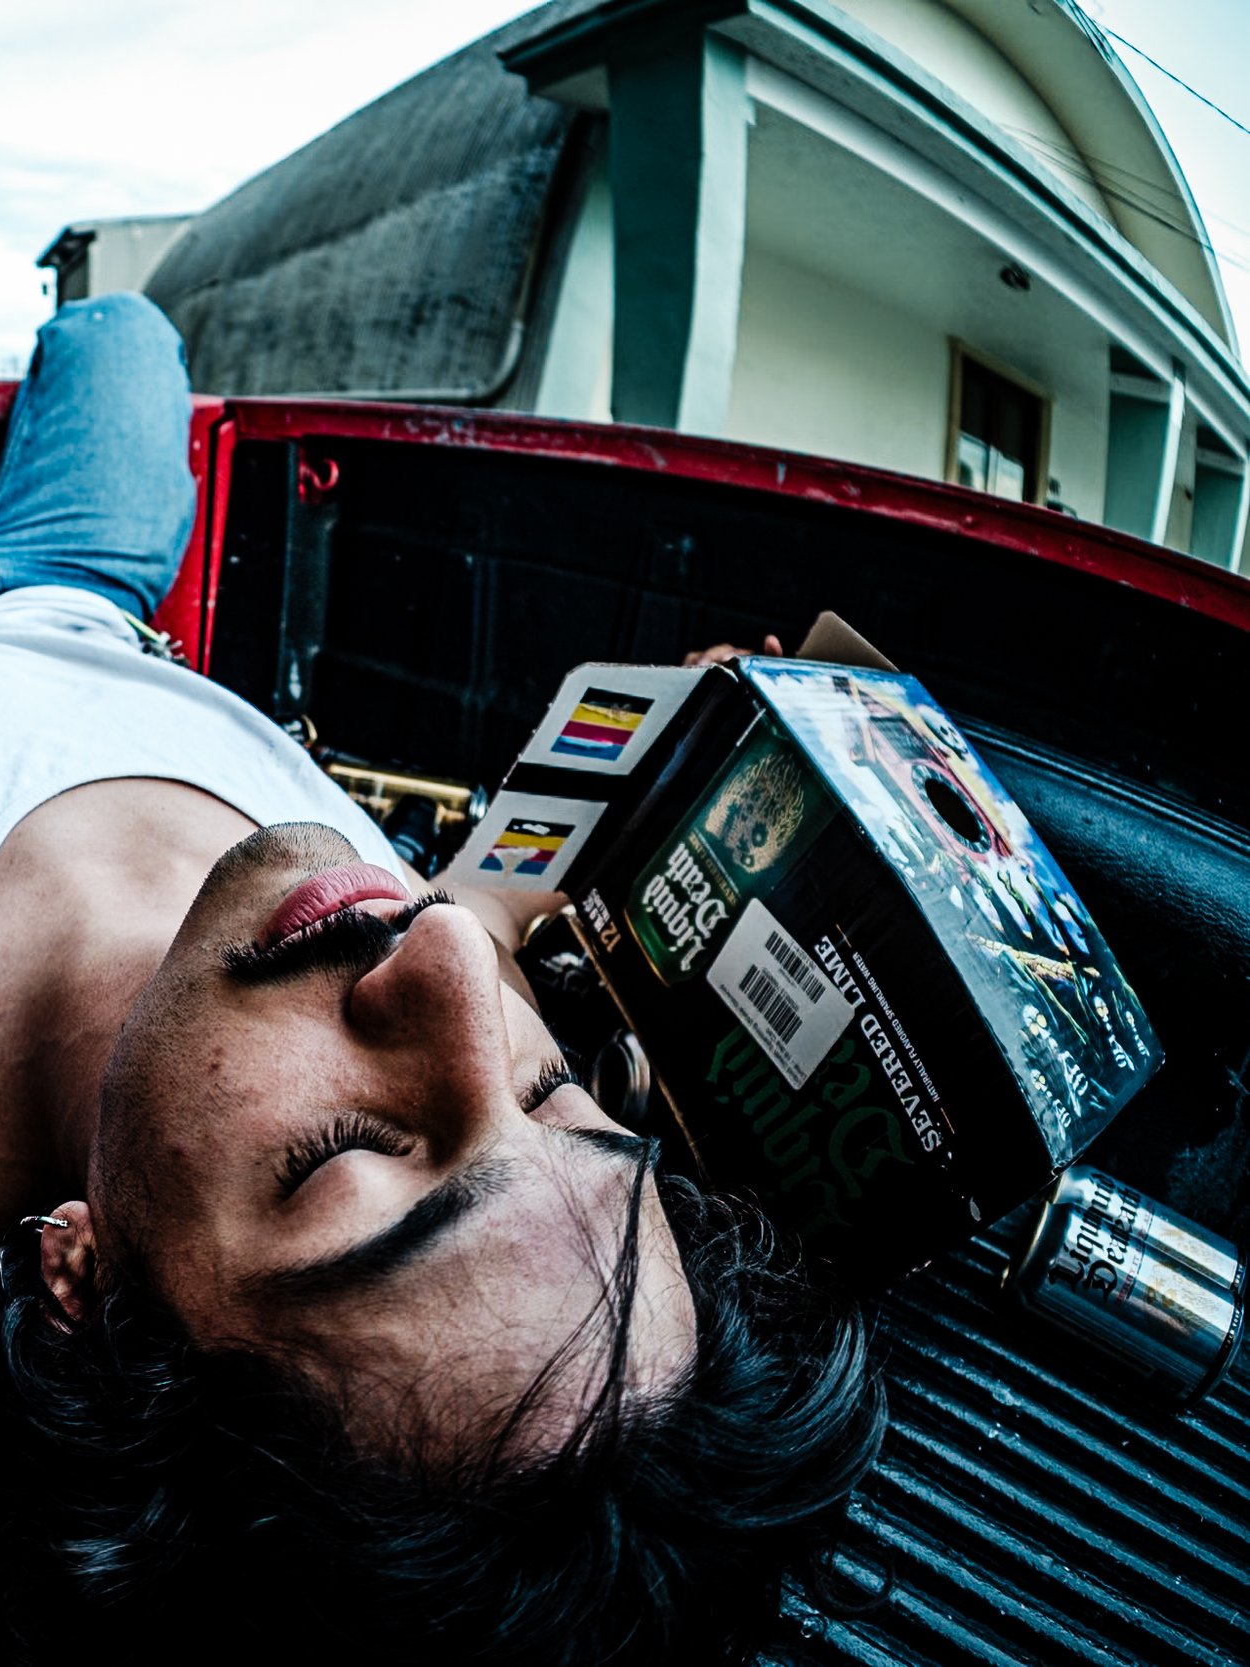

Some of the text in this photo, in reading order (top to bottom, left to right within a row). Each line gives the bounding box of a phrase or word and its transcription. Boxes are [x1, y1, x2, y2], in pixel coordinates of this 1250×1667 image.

[598, 920, 622, 954] 12
[642, 874, 707, 972] Liquid
[667, 843, 730, 939] Death
[813, 935, 942, 1153] SEVERED LIME
[851, 950, 941, 1102] NATURALLY FLAVORED SPARKLING WATER
[811, 1039, 915, 1201] Dea
